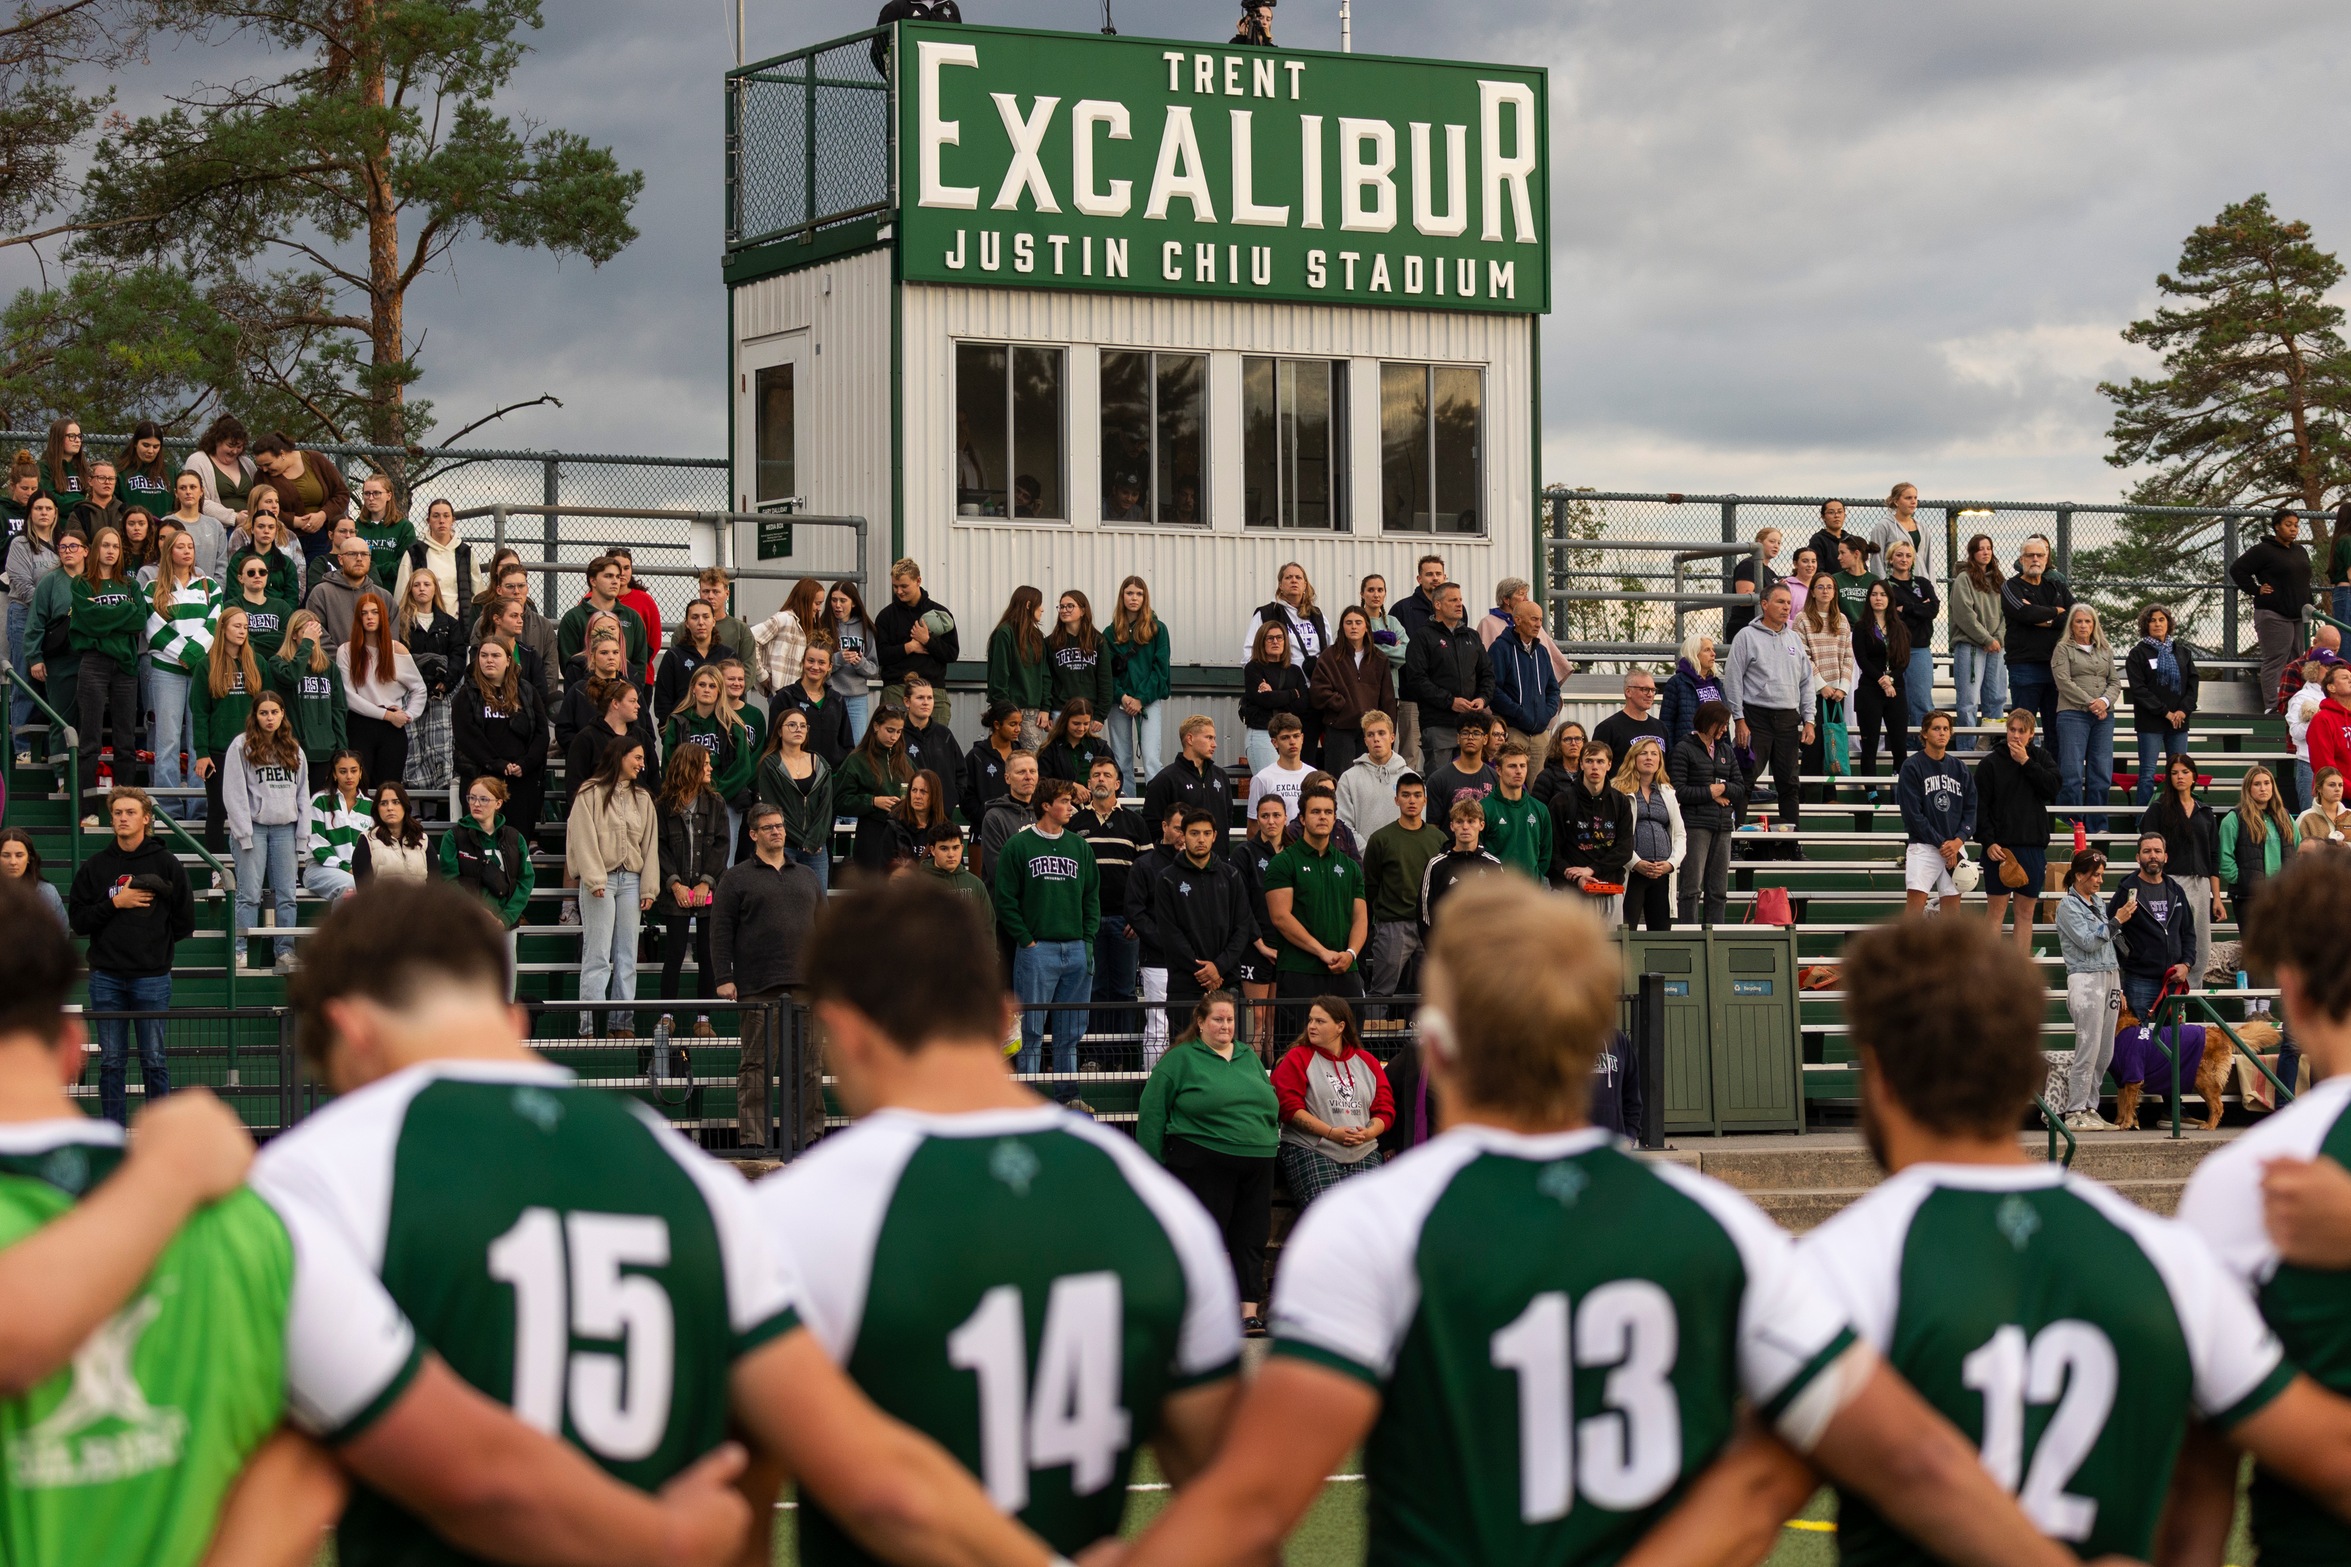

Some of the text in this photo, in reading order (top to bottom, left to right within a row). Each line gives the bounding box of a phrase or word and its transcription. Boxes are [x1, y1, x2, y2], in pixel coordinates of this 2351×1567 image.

[1162, 51, 1305, 100] TRENT
[916, 41, 1537, 243] EXCALIBUR
[945, 229, 1514, 299] JUSTIN CHIU STADIUM
[247, 612, 280, 631] RENT
[840, 636, 867, 654] ENT
[1056, 647, 1097, 666] TRENT
[1028, 856, 1078, 879] TRENT
[1329, 1099, 1363, 1109] VIKINGS
[488, 1206, 674, 1461] 15
[947, 1270, 1131, 1514] 14
[1490, 1278, 1681, 1525] 13
[1961, 1319, 2119, 1542] 12
